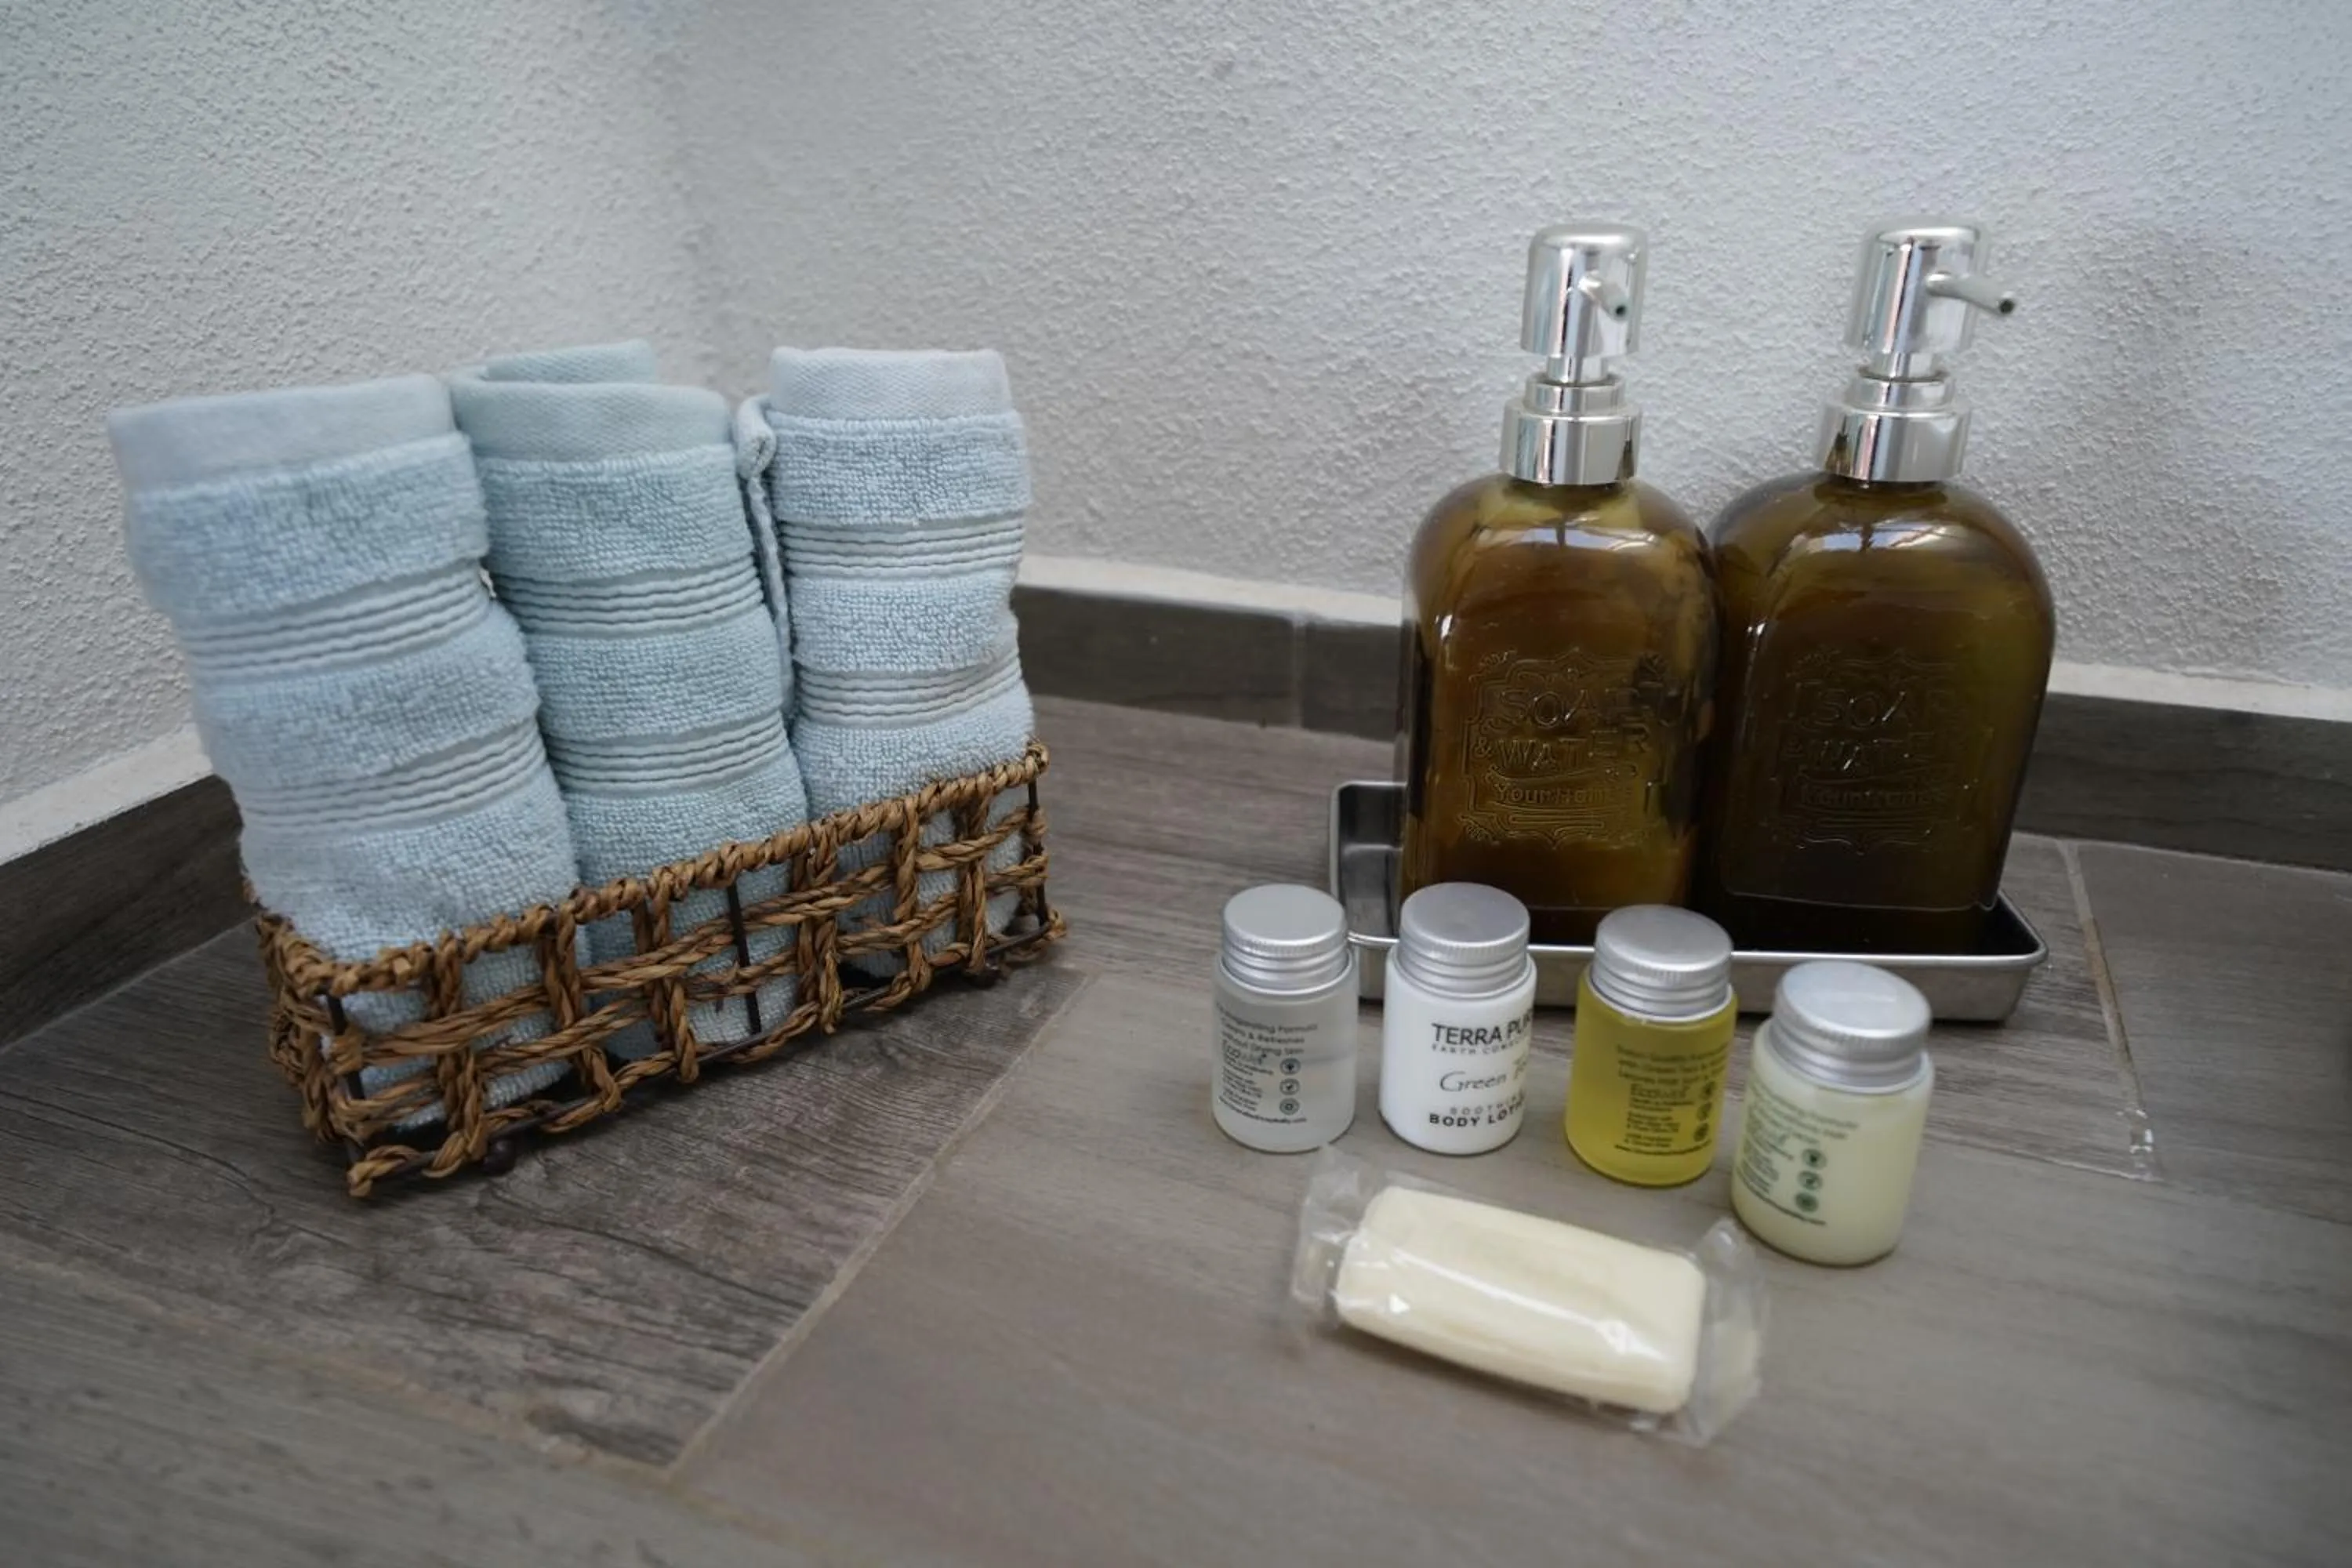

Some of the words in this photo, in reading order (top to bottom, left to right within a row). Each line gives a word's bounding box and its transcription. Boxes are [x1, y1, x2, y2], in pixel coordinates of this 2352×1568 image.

[1432, 1022, 1502, 1045] TERRA
[1506, 1009, 1532, 1040] PUR
[1439, 1070, 1507, 1092] Green
[1428, 1112, 1480, 1127] BODY
